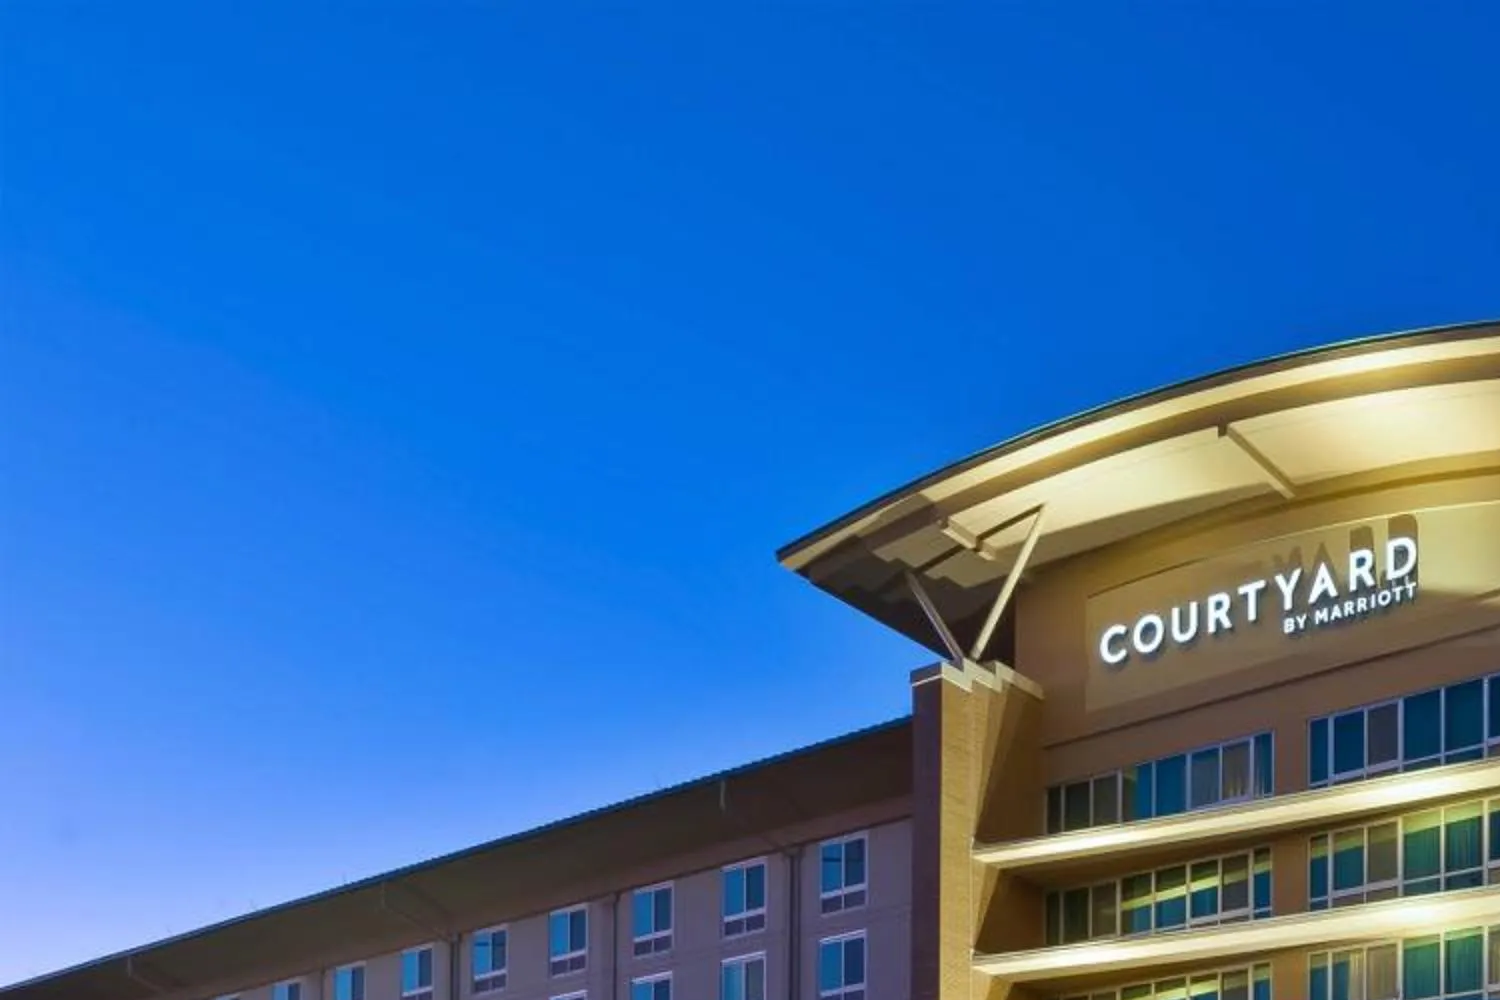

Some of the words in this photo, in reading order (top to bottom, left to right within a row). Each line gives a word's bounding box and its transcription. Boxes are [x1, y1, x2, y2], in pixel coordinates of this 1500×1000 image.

[1100, 537, 1417, 664] COURTYARD
[1283, 613, 1307, 634] BY
[1314, 581, 1417, 625] MARRIOTT
